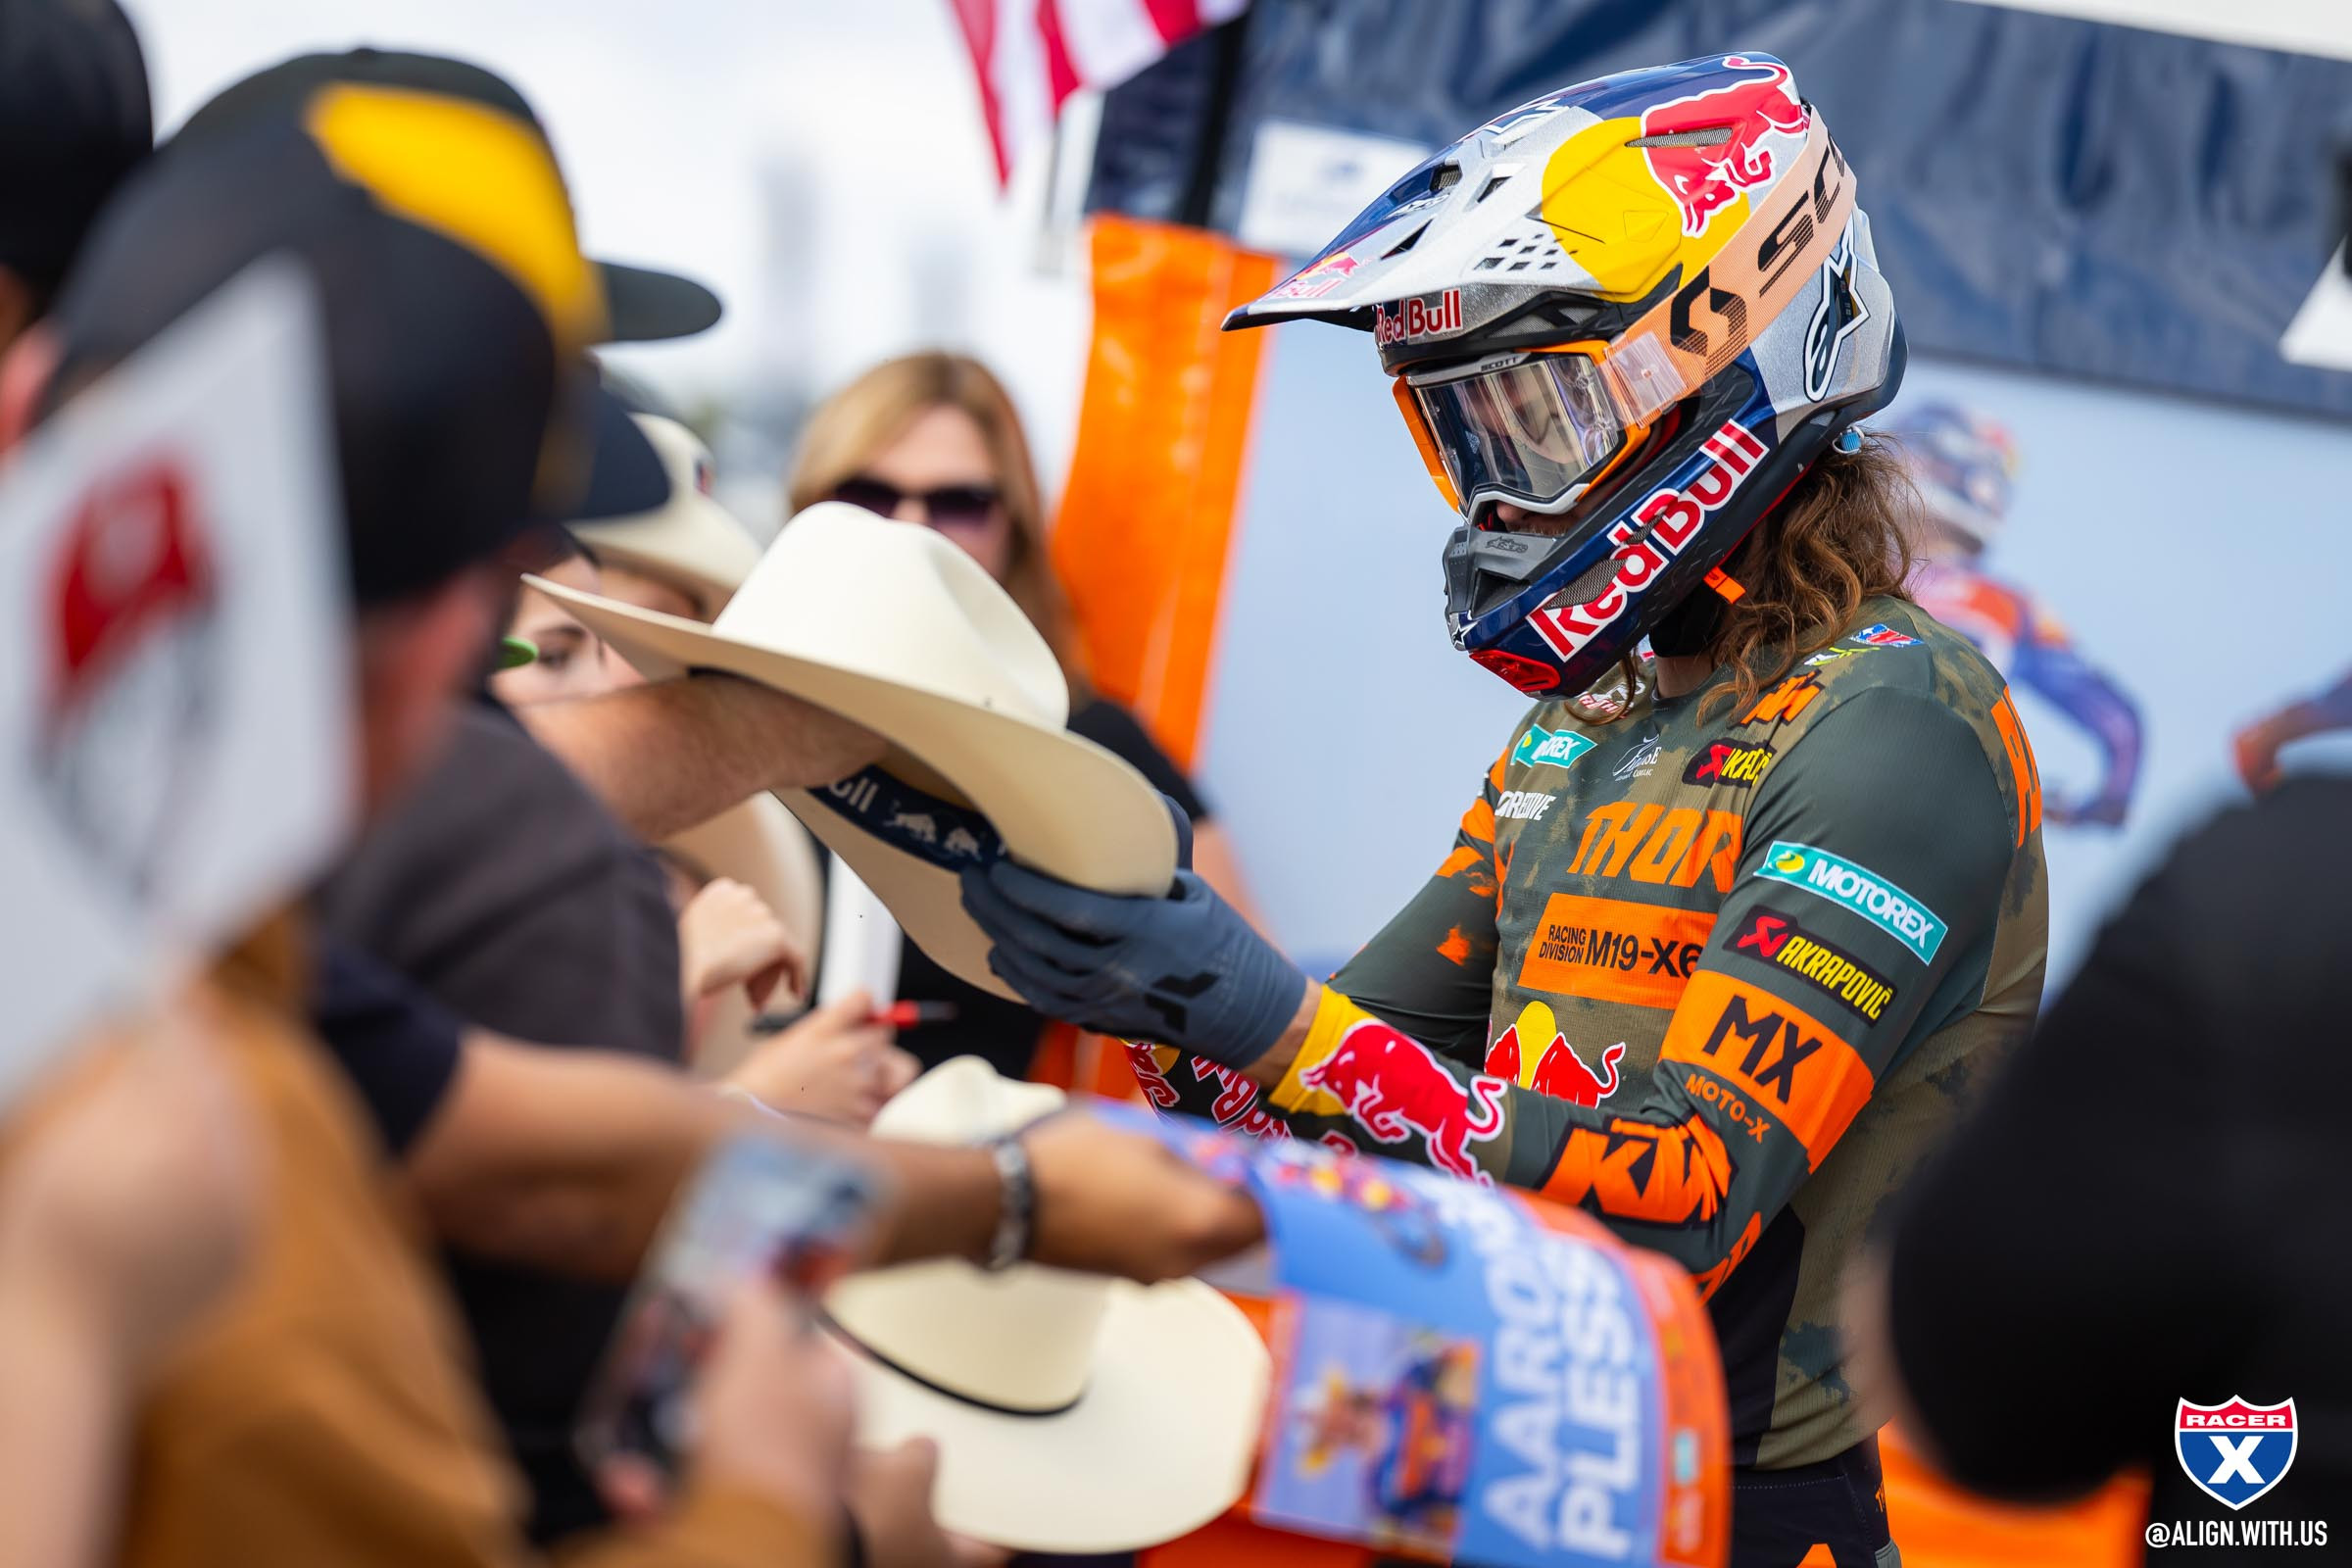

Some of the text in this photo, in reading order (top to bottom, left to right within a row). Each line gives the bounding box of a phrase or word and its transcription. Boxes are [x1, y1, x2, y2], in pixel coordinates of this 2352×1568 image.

[1407, 288, 1463, 337] Bull
[1481, 356, 1519, 371] SCOTT
[1631, 419, 1768, 556] Bull
[1566, 801, 1743, 894] THOR
[1547, 924, 1587, 946] RACING
[1807, 858, 1935, 950] MOTOREX
[1539, 941, 1585, 964] DIVISION
[1776, 935, 1894, 1021] AKRAPOVIČ
[1701, 994, 1824, 1105] MX
[1685, 1072, 1771, 1145] MOTO-X
